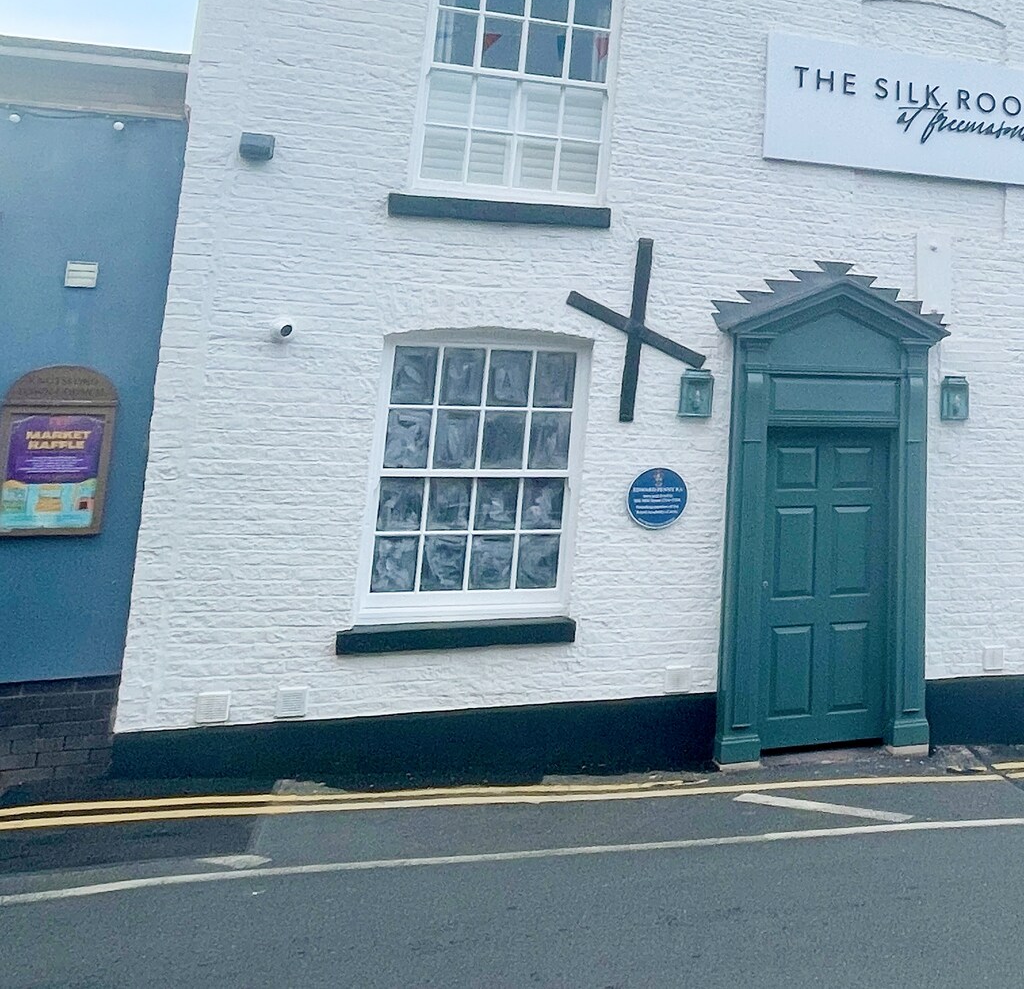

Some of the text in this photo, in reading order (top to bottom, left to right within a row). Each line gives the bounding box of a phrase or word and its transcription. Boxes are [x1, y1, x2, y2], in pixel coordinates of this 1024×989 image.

[794, 65, 857, 96] THE
[874, 77, 941, 107] SILK
[26, 431, 92, 441] MARKET
[27, 440, 86, 450] RAFFLE
